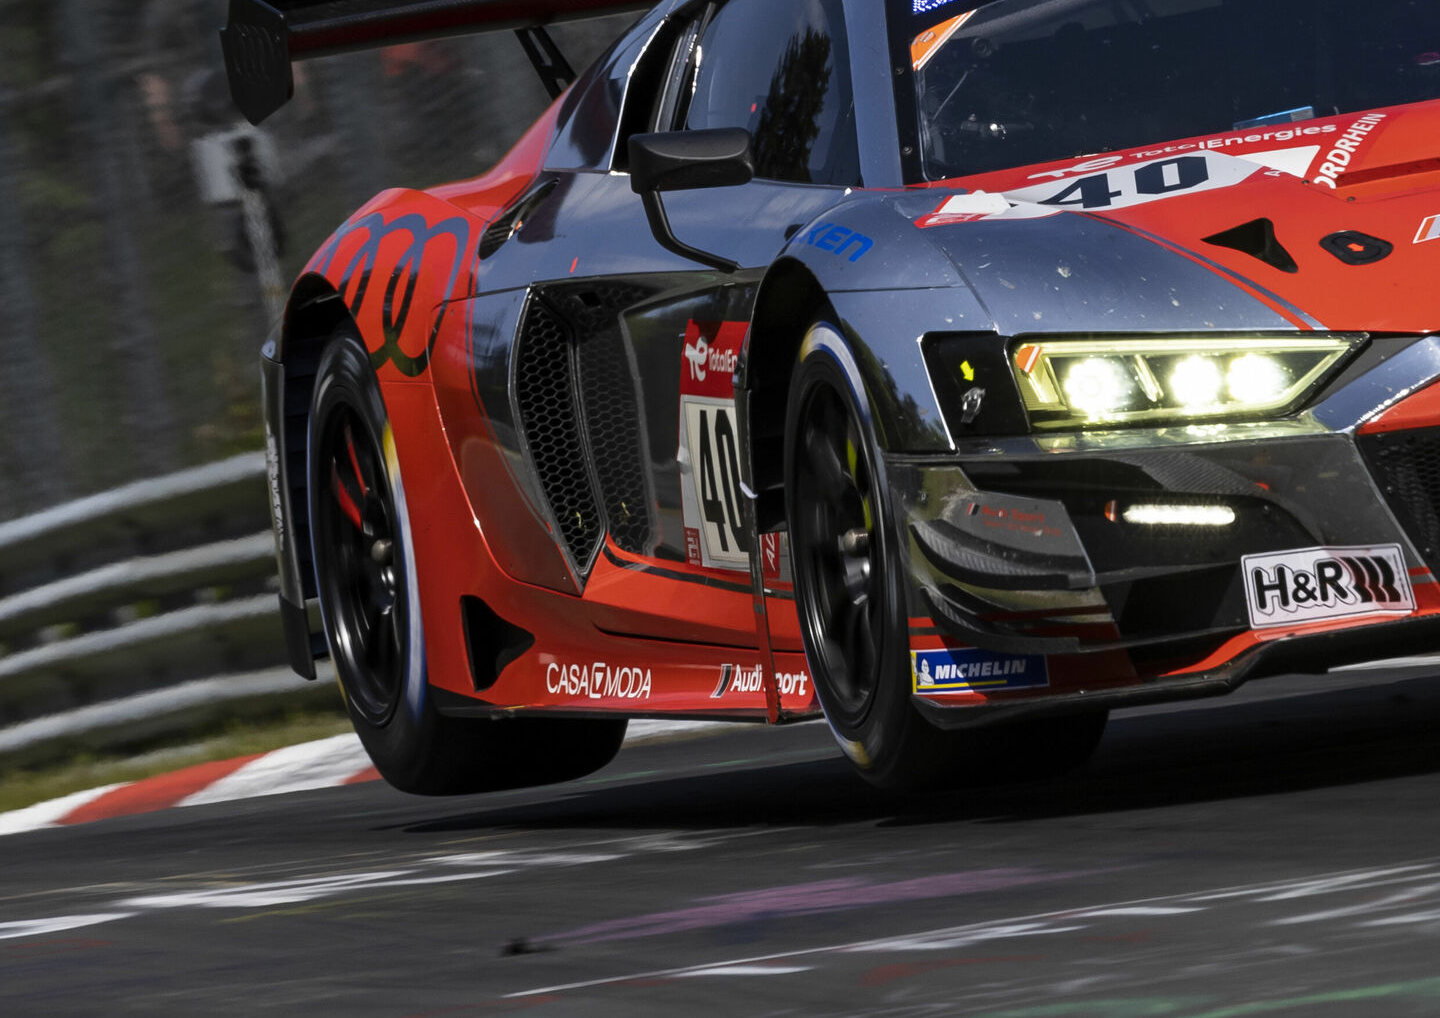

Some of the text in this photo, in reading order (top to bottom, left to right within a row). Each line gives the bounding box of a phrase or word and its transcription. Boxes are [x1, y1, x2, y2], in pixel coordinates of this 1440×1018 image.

[1129, 124, 1337, 159] TotalEnergies
[1037, 156, 1209, 209] 40
[699, 409, 750, 552] 40
[1253, 559, 1349, 610] H&R
[730, 664, 808, 696] Audi port
[935, 659, 1026, 680] MICHELIN
